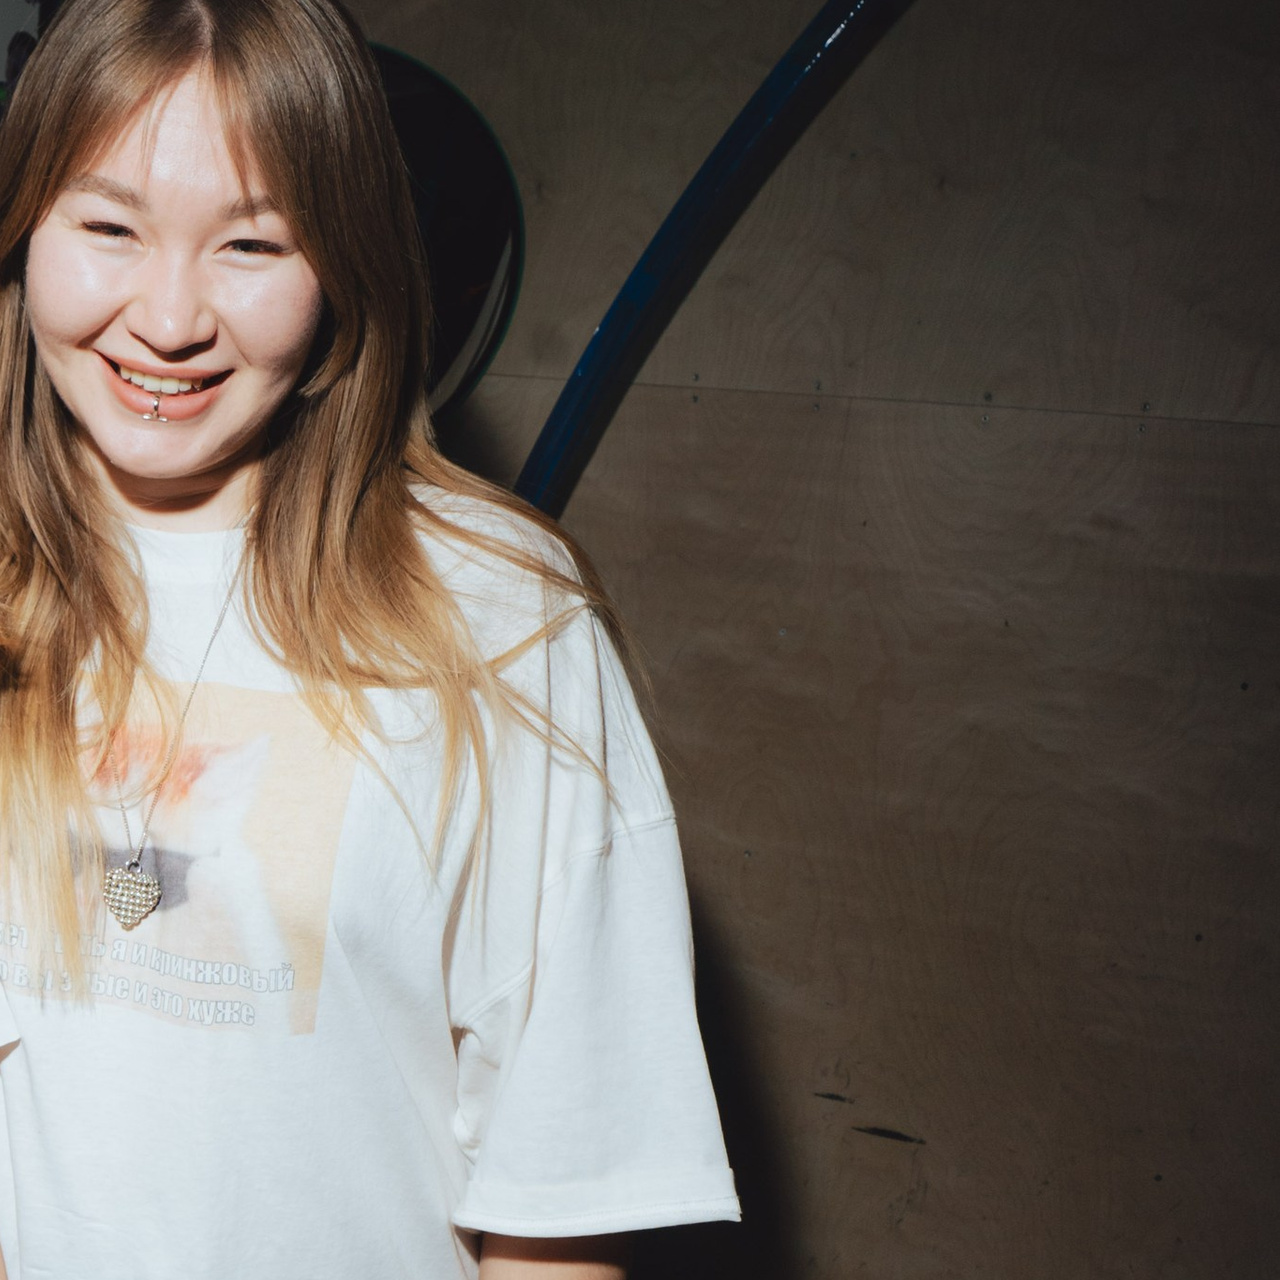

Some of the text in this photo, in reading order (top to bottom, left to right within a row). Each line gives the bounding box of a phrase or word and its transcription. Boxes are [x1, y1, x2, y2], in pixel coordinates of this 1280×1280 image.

[150, 947, 296, 993] кринжовый
[151, 986, 184, 1018] это
[187, 996, 256, 1027] хуже
